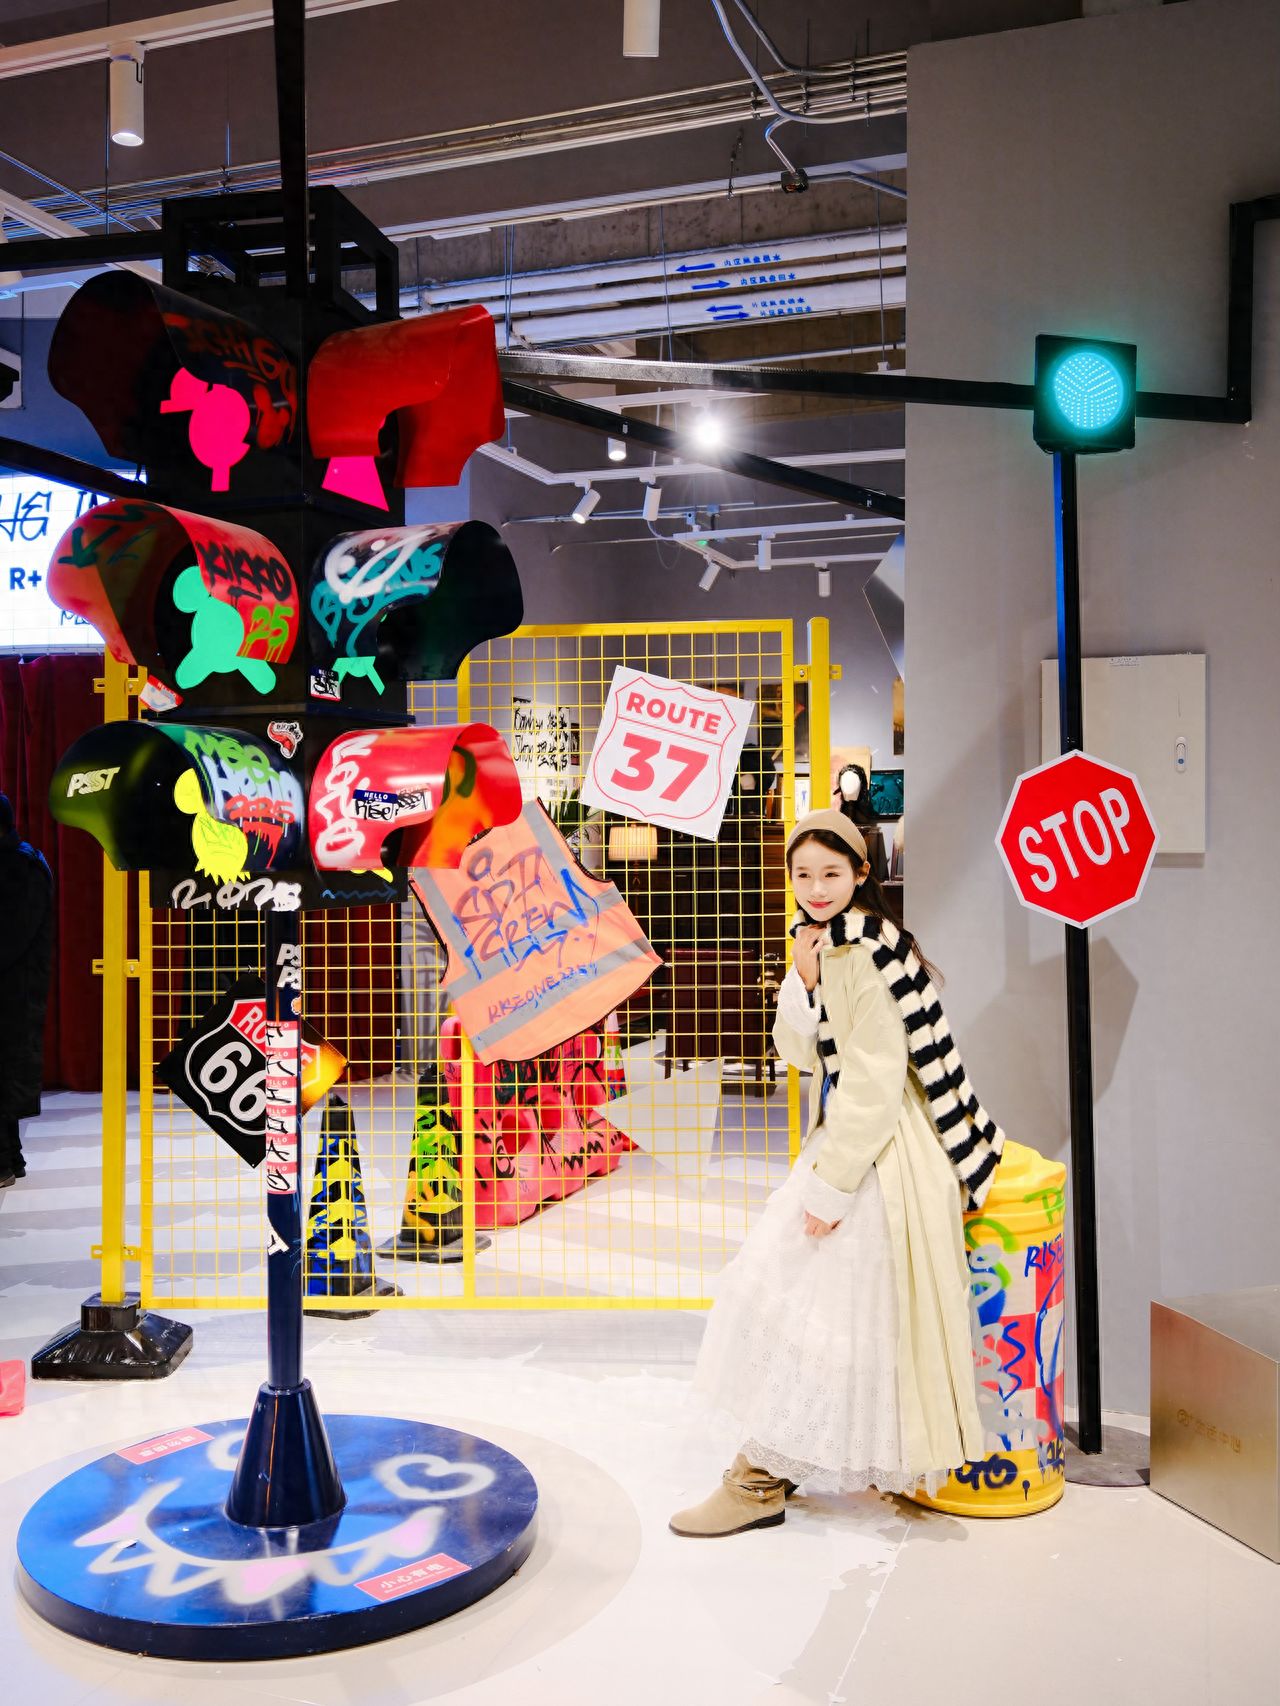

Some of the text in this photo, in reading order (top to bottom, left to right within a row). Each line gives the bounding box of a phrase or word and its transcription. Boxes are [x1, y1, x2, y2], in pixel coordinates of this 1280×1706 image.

[246, 603, 294, 650] 25
[626, 692, 722, 735] ROUTE
[363, 791, 389, 800] HELLO
[610, 732, 709, 802] 37
[1018, 787, 1130, 893] STOP
[200, 1041, 266, 1122] 66
